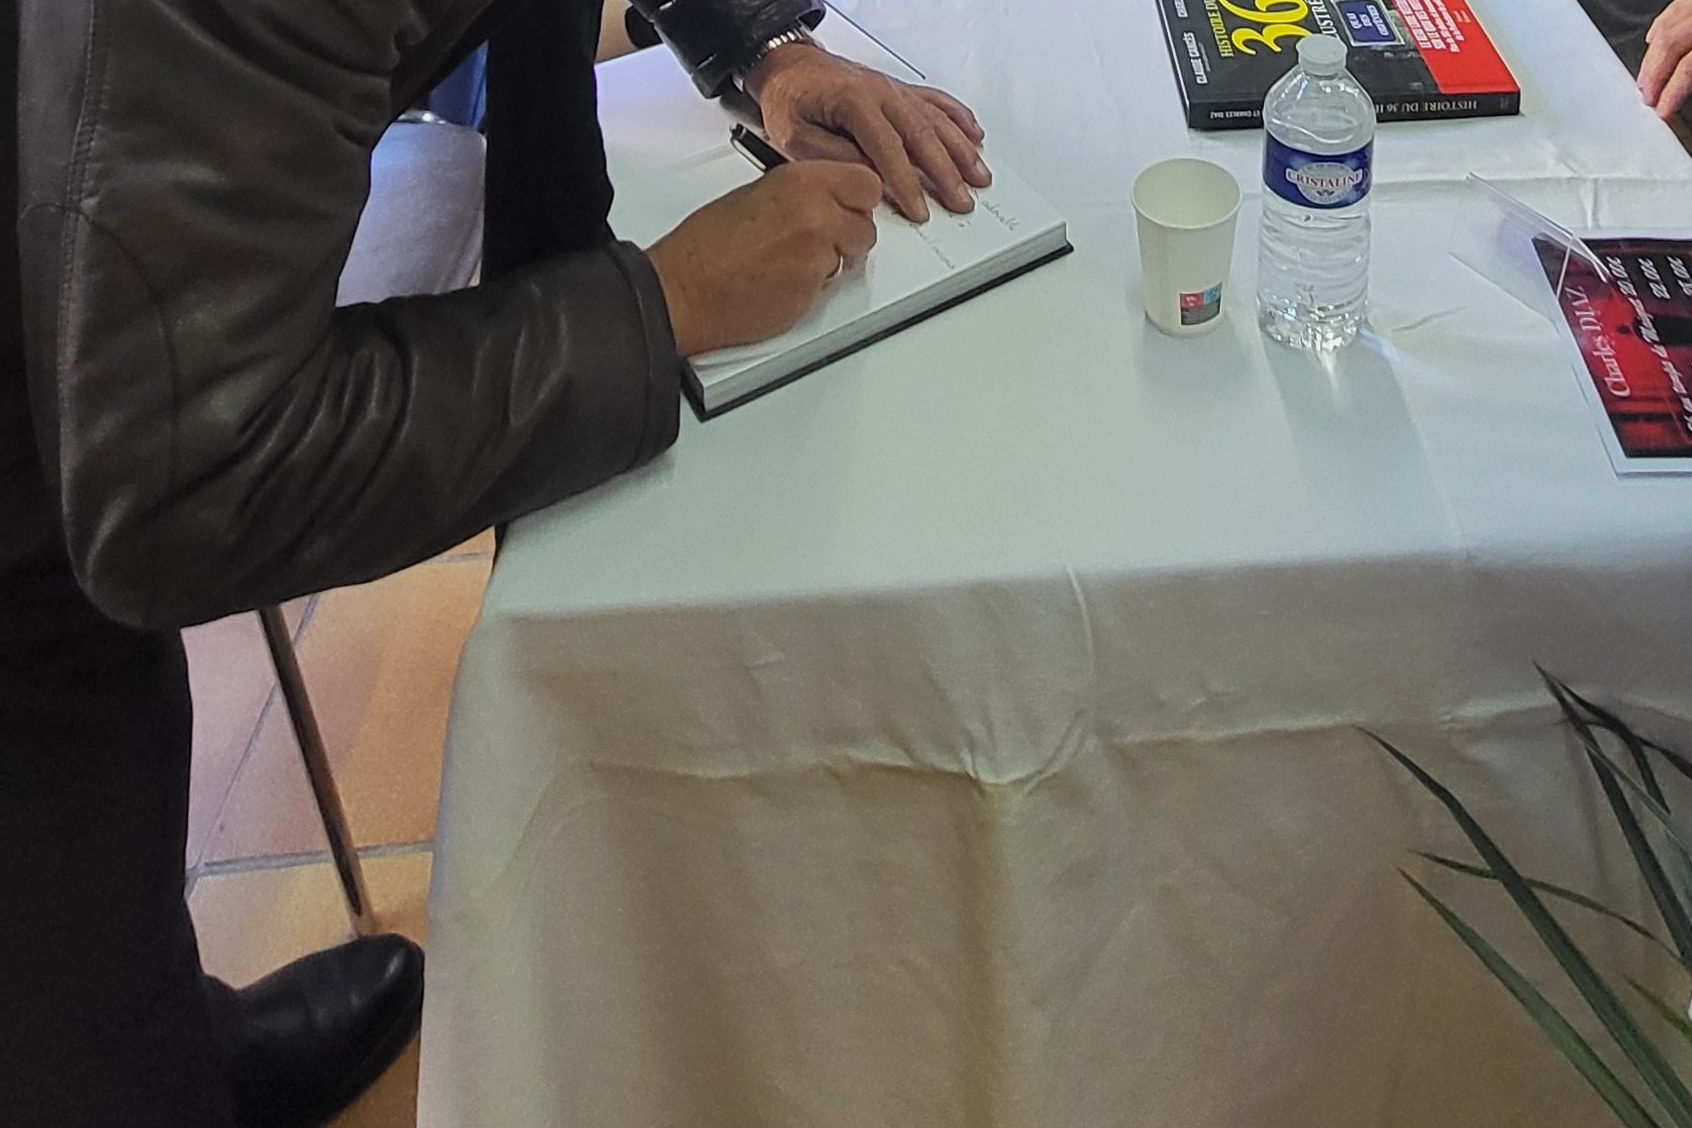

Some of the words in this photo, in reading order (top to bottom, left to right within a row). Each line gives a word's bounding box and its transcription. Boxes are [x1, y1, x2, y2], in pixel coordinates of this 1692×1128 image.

[1208, 10, 1234, 58] HISTOIRE
[1386, 103, 1398, 113] 36
[1402, 102, 1419, 112] DU
[1424, 100, 1477, 111] HISTOIRE
[1565, 287, 1601, 331] DIAZ
[1592, 335, 1631, 397] Charles
